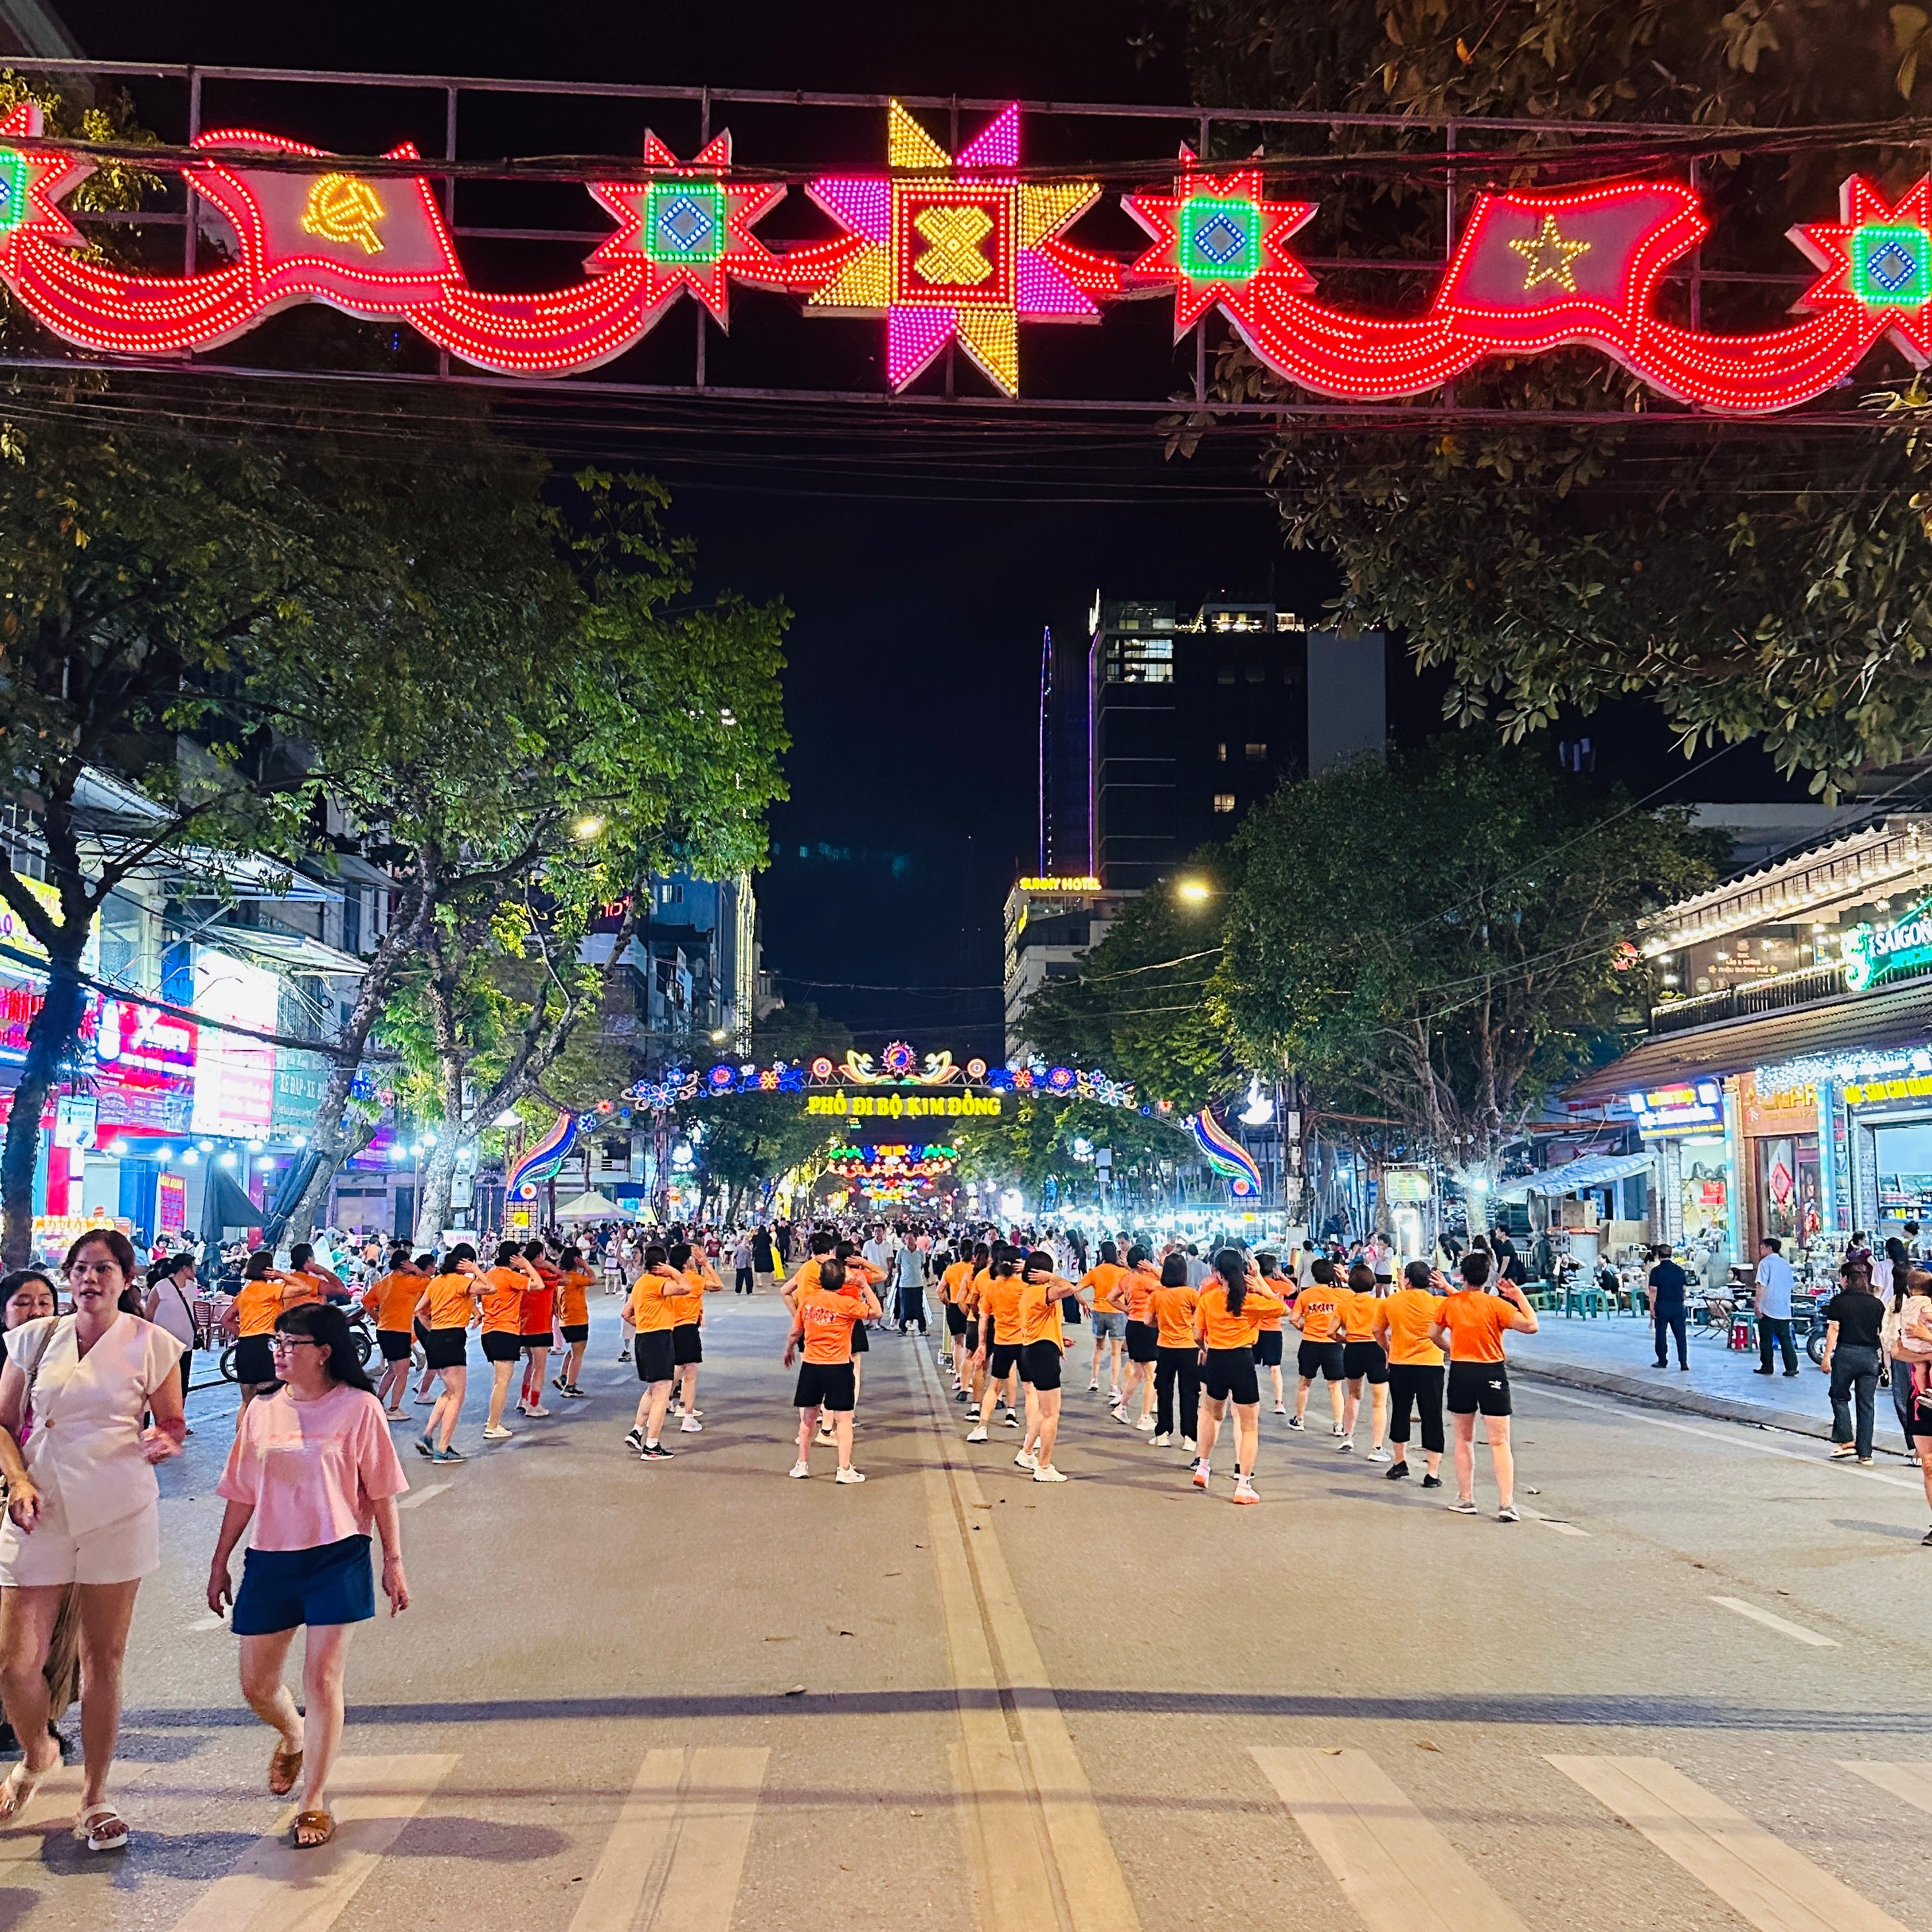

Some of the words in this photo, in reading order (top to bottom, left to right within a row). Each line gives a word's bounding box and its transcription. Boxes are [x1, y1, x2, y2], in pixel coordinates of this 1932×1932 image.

[1020, 877, 1061, 891] SUNNY
[1061, 877, 1102, 891] HOTEL
[1875, 918, 1932, 955] SAIGON
[279, 1073, 290, 1094] XE
[306, 1080, 316, 1099] XE
[807, 1088, 848, 1116] PHỐ
[852, 1096, 874, 1116] ĐI
[876, 1093, 904, 1120] BỘ
[906, 1096, 946, 1116] KIM
[947, 1088, 1002, 1116] ĐỒNG
